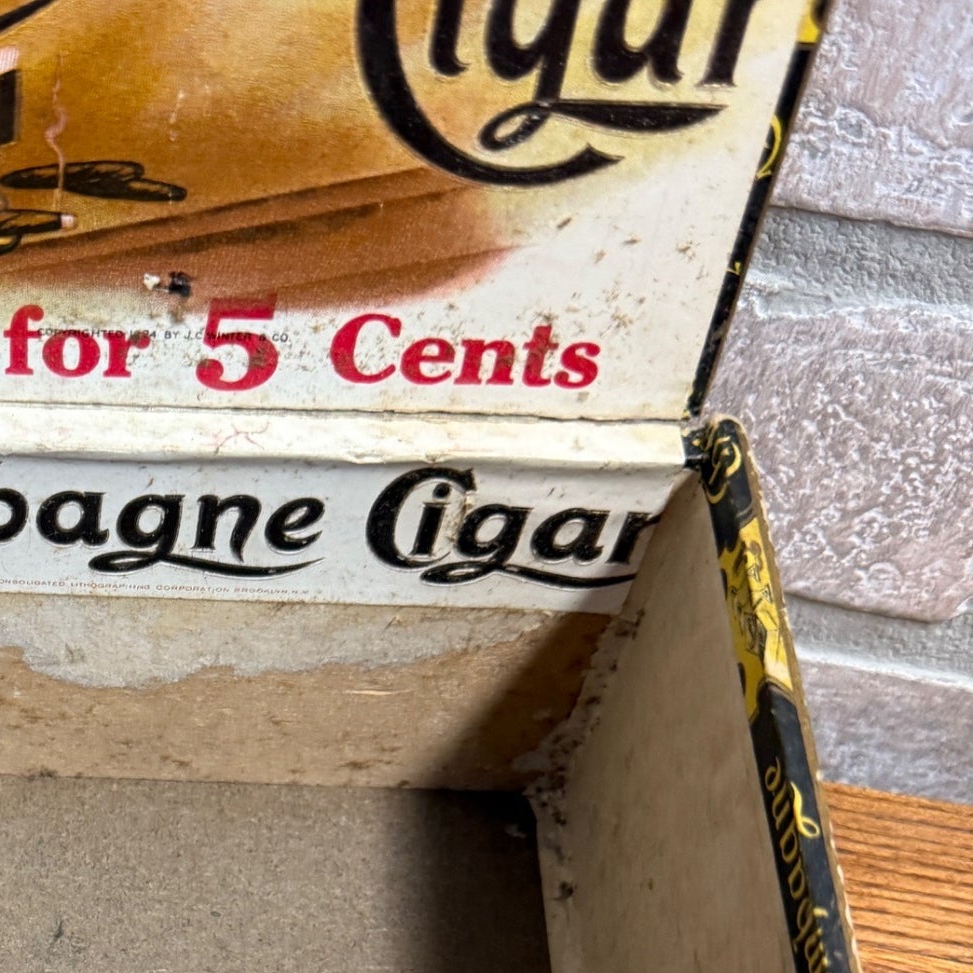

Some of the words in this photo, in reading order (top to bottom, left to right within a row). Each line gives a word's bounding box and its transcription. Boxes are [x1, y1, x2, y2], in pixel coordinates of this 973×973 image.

[3, 304, 151, 378] for
[195, 293, 279, 391] 5
[329, 313, 602, 390] Cents
[164, 331, 180, 340] BY
[365, 466, 661, 589] Cigar
